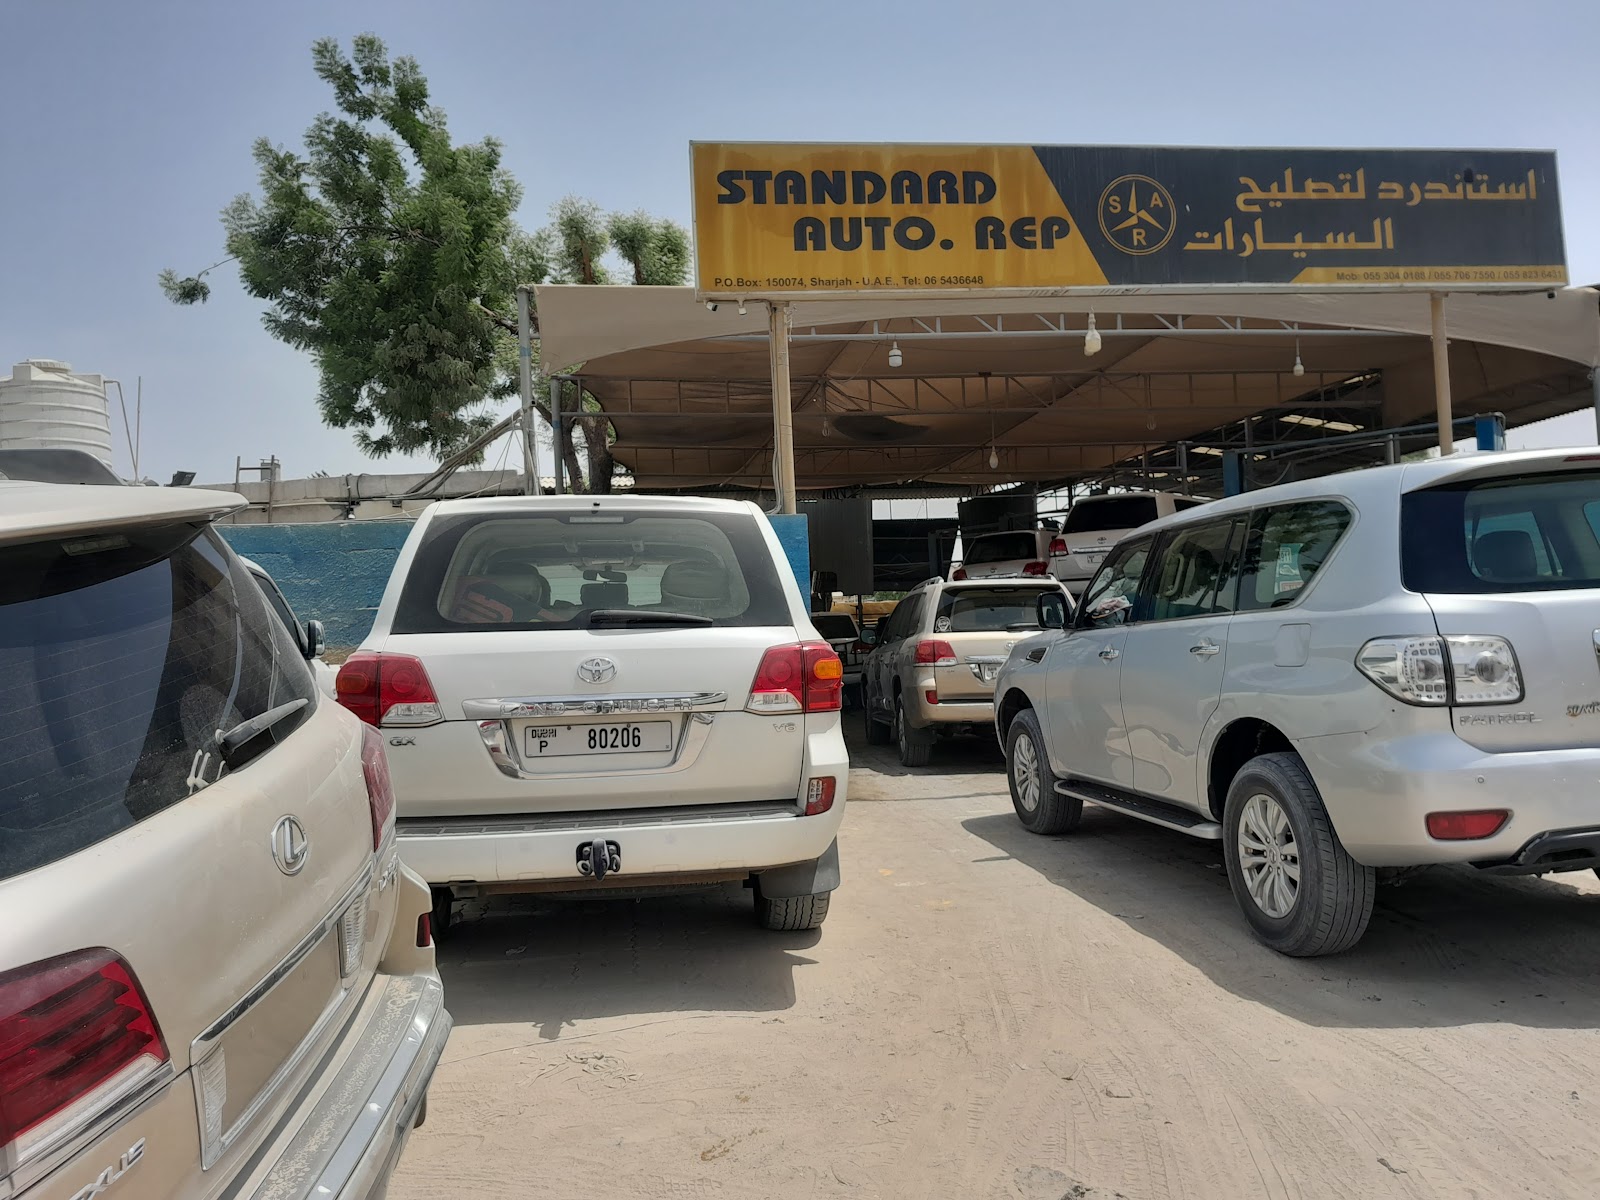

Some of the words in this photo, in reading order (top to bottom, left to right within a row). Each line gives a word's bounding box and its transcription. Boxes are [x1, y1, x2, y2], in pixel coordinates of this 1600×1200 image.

[716, 169, 996, 204] STANDARD
[1235, 167, 1366, 212] لتصليح
[793, 215, 954, 251] AUTO.
[974, 215, 1070, 249] REP
[714, 277, 762, 287] P.O.Box:
[765, 277, 807, 288] 150074,
[810, 276, 852, 288] Sharjah
[901, 275, 921, 286] Tel:
[924, 275, 937, 285] 06
[940, 275, 984, 285] 5436648
[500, 702, 566, 717] LAND
[539, 740, 549, 753] P
[588, 727, 641, 749] 80206
